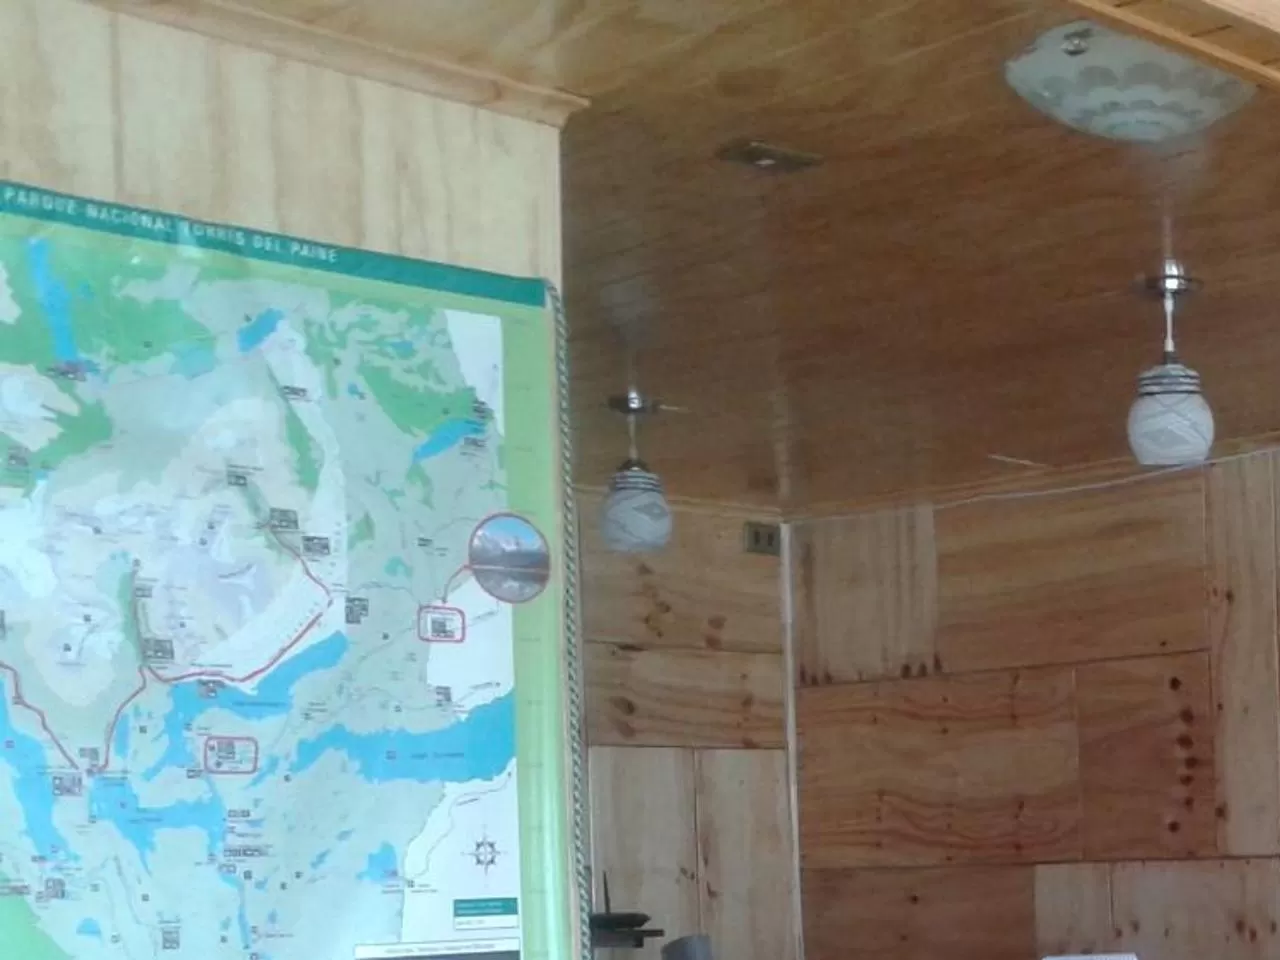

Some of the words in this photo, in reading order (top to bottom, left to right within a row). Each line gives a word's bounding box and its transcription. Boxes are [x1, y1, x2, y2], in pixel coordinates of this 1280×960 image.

[4, 186, 77, 216] PARQUE
[86, 203, 173, 233] NACIONAL
[252, 234, 281, 252] DEL
[290, 241, 338, 263] PAINE
